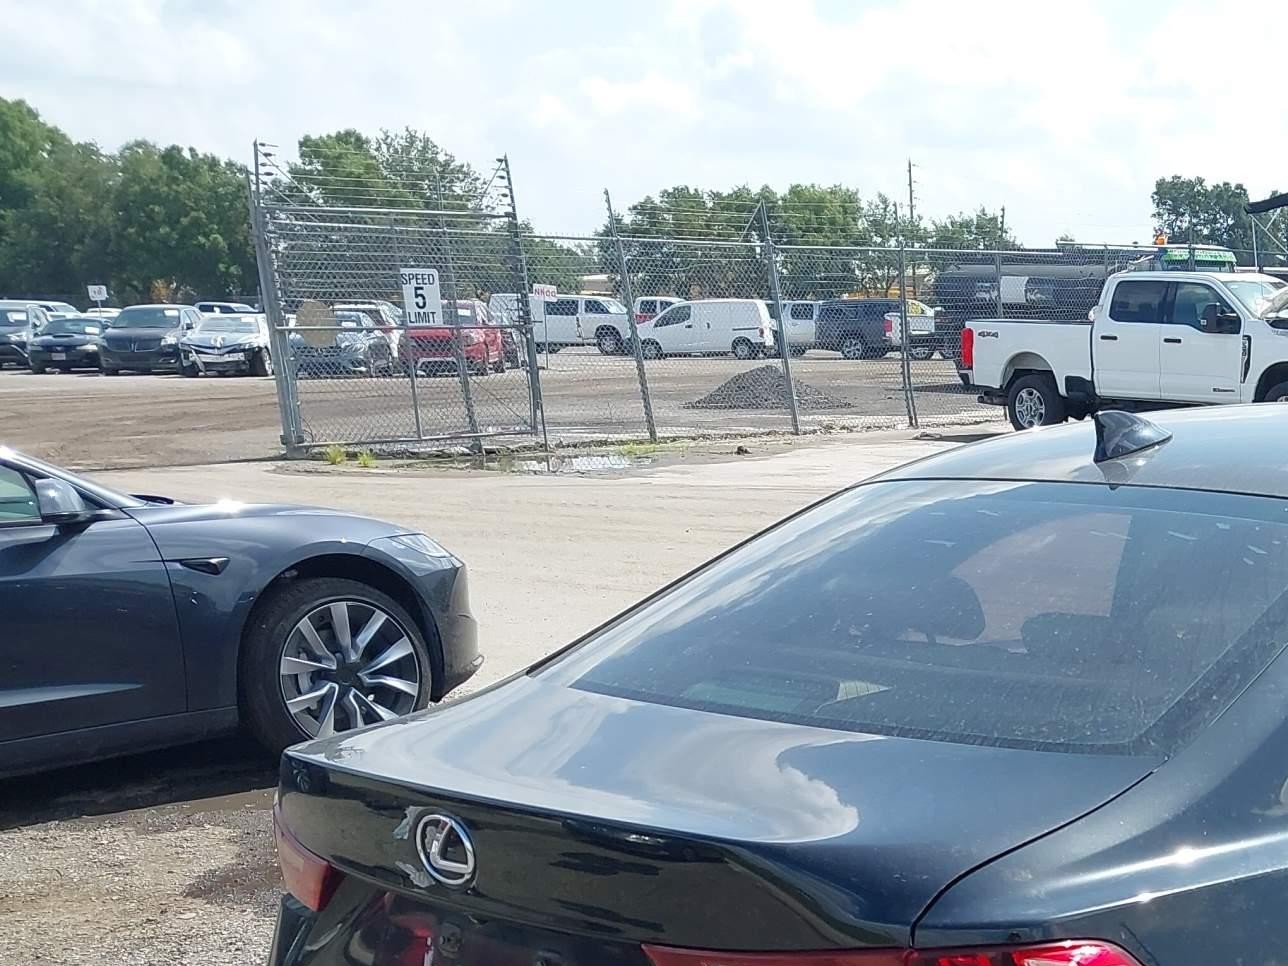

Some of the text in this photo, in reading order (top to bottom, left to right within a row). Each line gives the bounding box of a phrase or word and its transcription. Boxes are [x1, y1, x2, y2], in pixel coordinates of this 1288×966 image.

[400, 273, 435, 285] SPEED
[414, 286, 427, 310] 5
[407, 311, 436, 324] LIMIT
